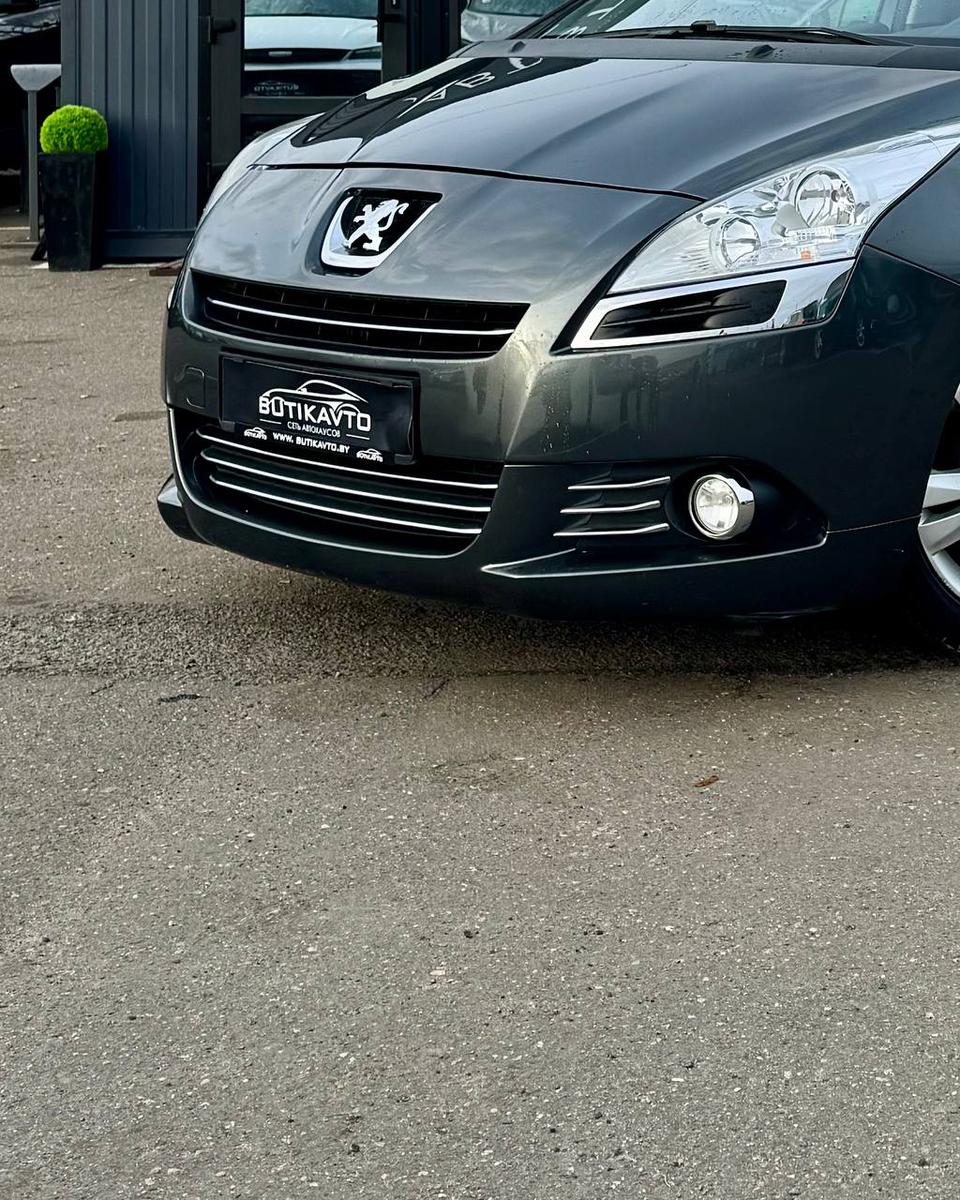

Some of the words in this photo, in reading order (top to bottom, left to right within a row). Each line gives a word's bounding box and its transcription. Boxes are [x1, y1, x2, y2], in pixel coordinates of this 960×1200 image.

[258, 395, 371, 432] BUTIKAVTO
[272, 432, 294, 443] WWW.
[295, 436, 350, 454] BUTIKAVTO.BY
